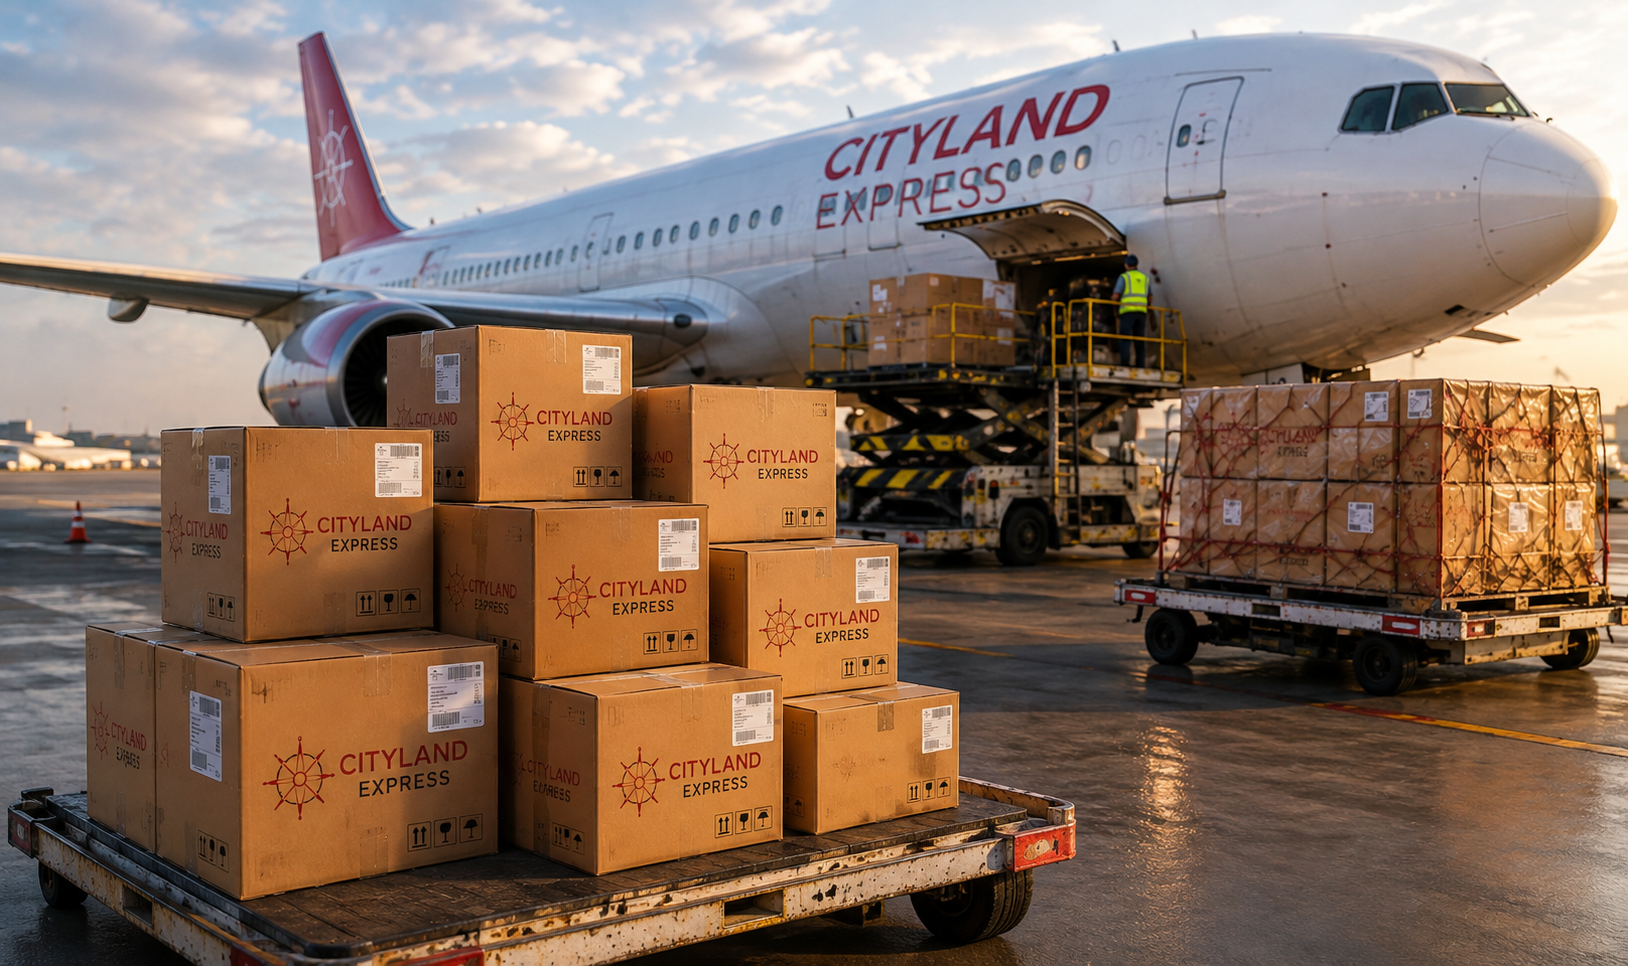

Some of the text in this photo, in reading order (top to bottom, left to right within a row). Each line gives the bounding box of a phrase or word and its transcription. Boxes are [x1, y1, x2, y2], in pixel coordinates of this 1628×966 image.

[824, 84, 1110, 181] CITYLAND
[816, 162, 1006, 230] EXPRESS
[415, 411, 458, 426] CITYLAND
[537, 410, 613, 426] CITYLAND
[548, 430, 601, 442] EXPRESS
[747, 449, 818, 464] CITYLAND
[758, 468, 808, 479] EXPRESS
[186, 520, 228, 540] CITYLAND
[317, 515, 412, 533] CITYLAND
[331, 537, 398, 552] EXPRESS
[600, 578, 687, 598] CITYLAND
[612, 599, 674, 616] EXPRESS
[804, 608, 880, 628] CITYLAND
[815, 628, 869, 644] EXPRESS
[339, 740, 468, 775] CITYLAND
[669, 751, 762, 780] CITYLAND
[359, 769, 450, 798] EXPRESS
[527, 760, 580, 787] CITYLAND
[683, 775, 748, 798] EXPRESS
